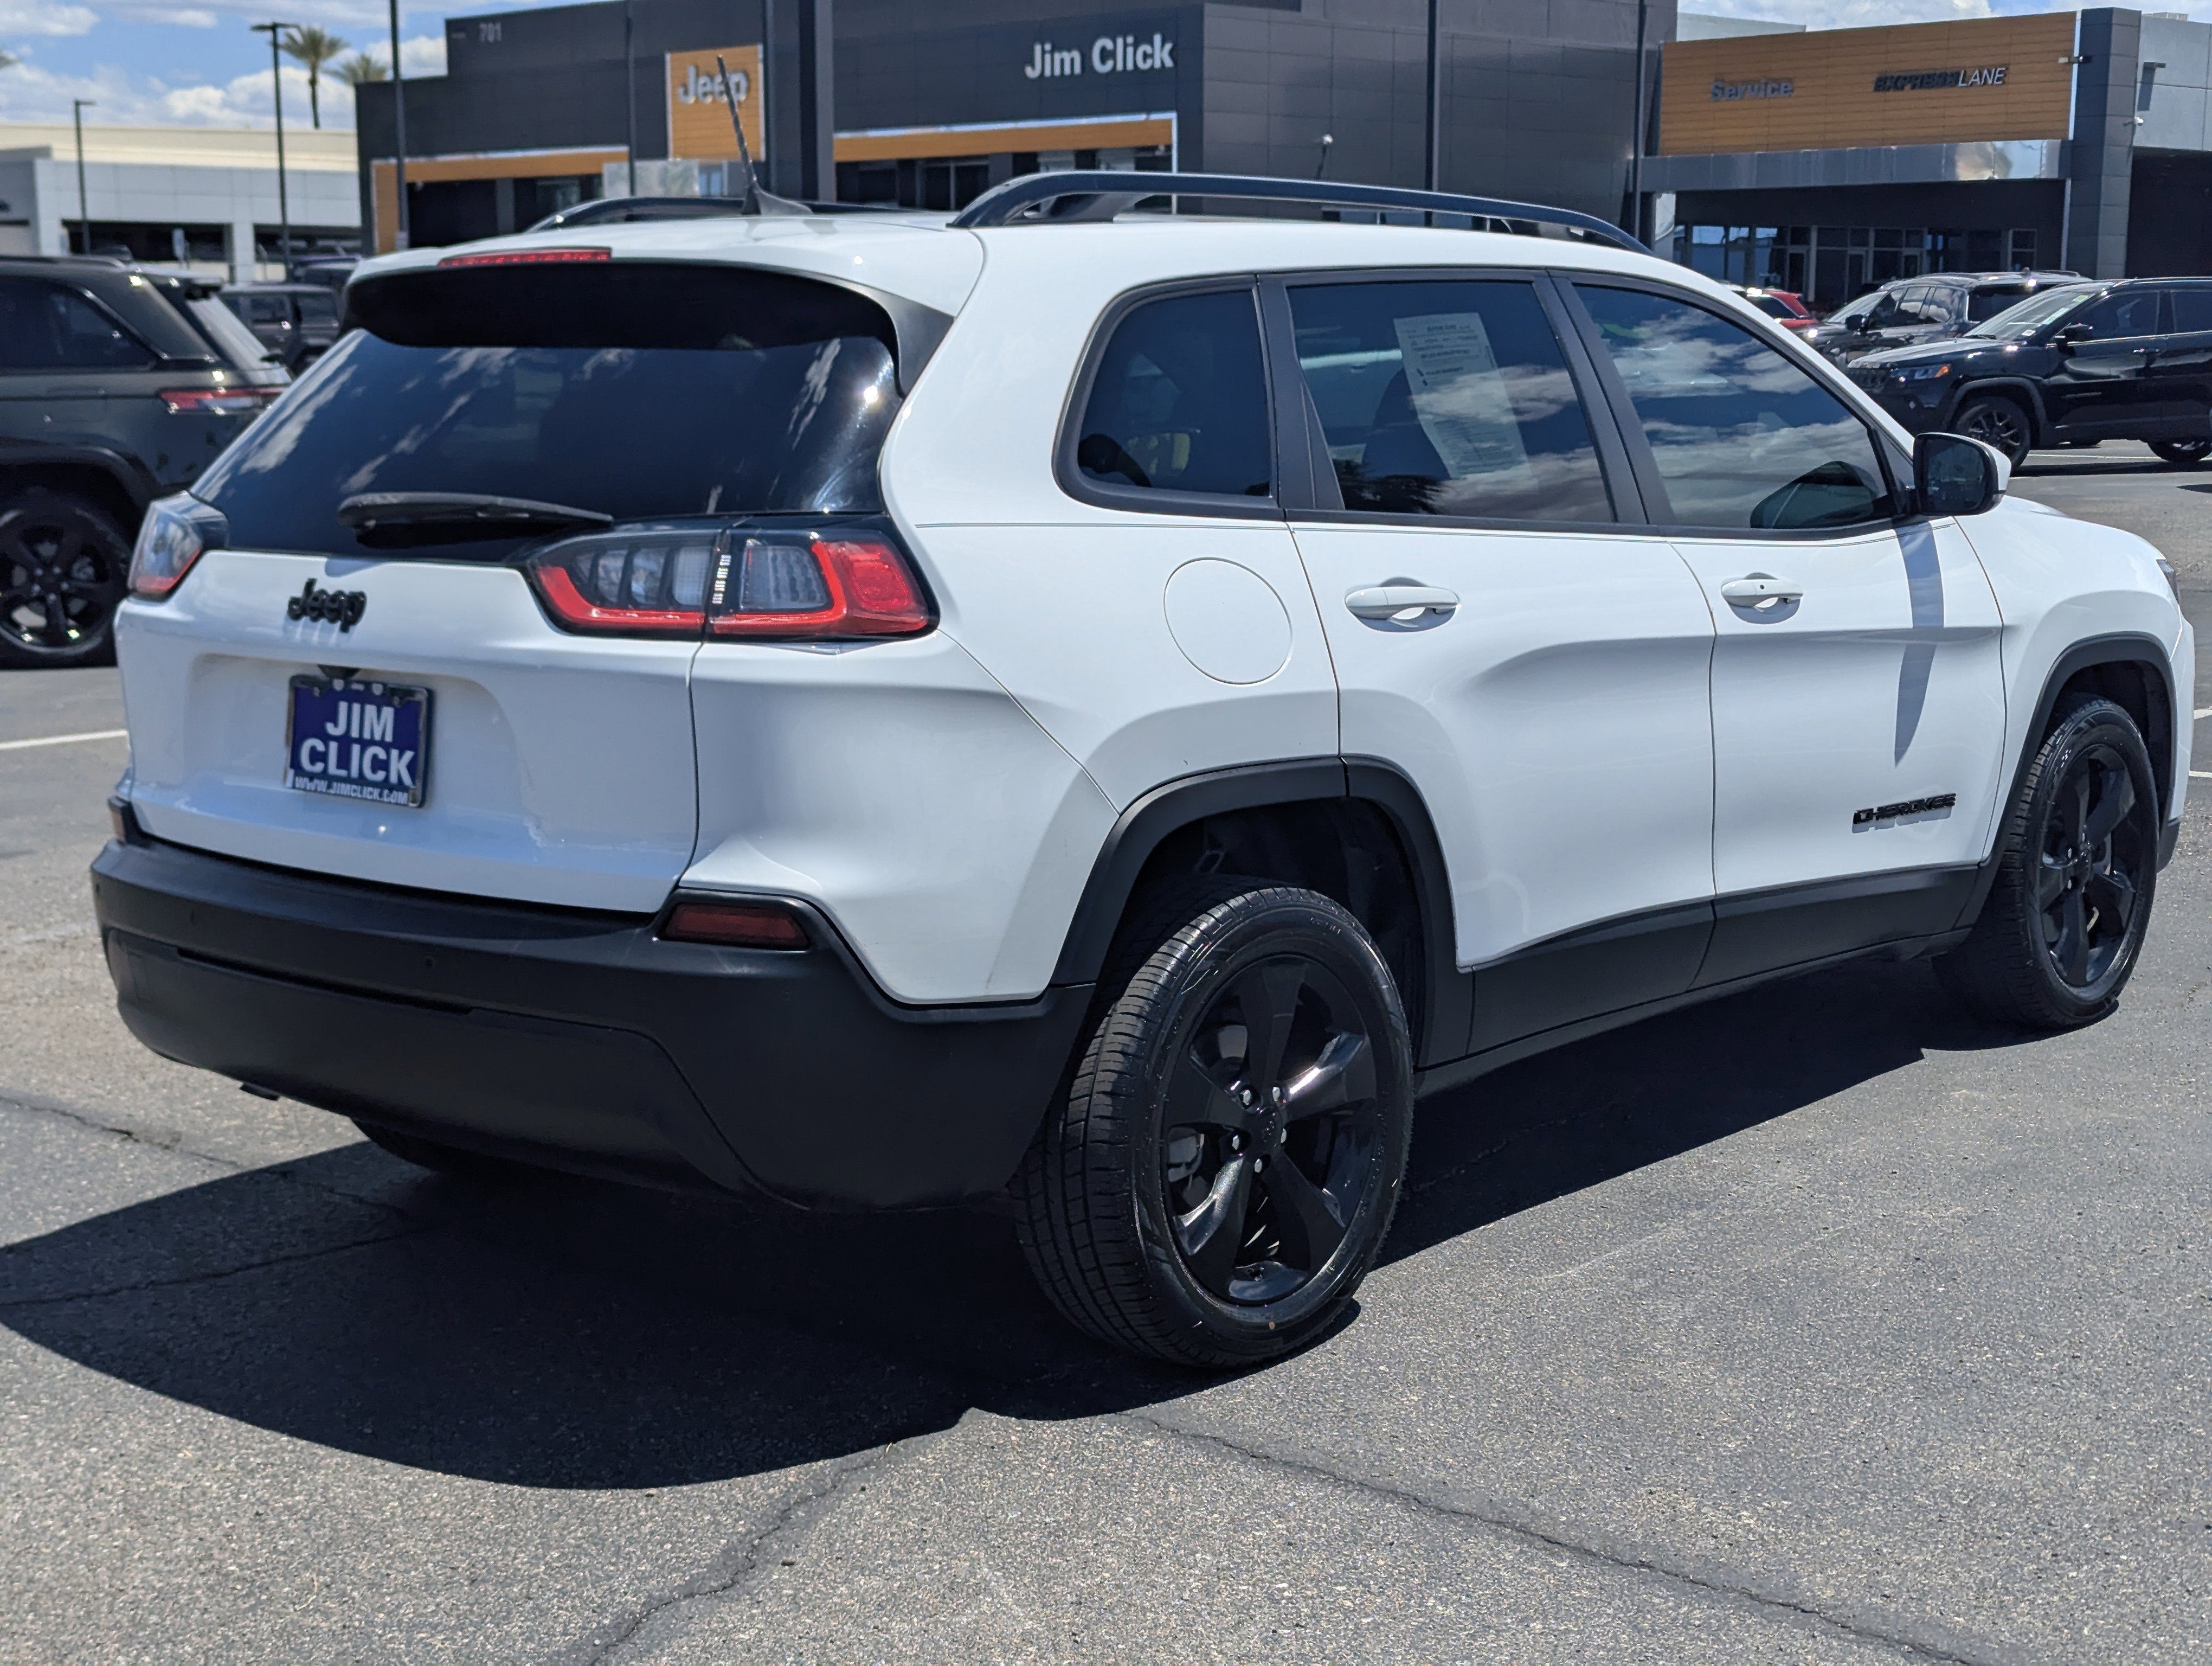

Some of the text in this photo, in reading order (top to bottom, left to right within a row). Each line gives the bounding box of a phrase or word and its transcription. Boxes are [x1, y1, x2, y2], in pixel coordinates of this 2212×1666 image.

[479, 23, 502, 43] 701
[1025, 32, 1174, 79] Jim Click
[678, 65, 749, 111] Jeep
[1711, 80, 1794, 102] Service
[287, 577, 367, 633] Jeep
[325, 701, 394, 743] JIM
[300, 737, 416, 789] CLICK
[295, 776, 409, 805] WWW.JIMCLICK.COM
